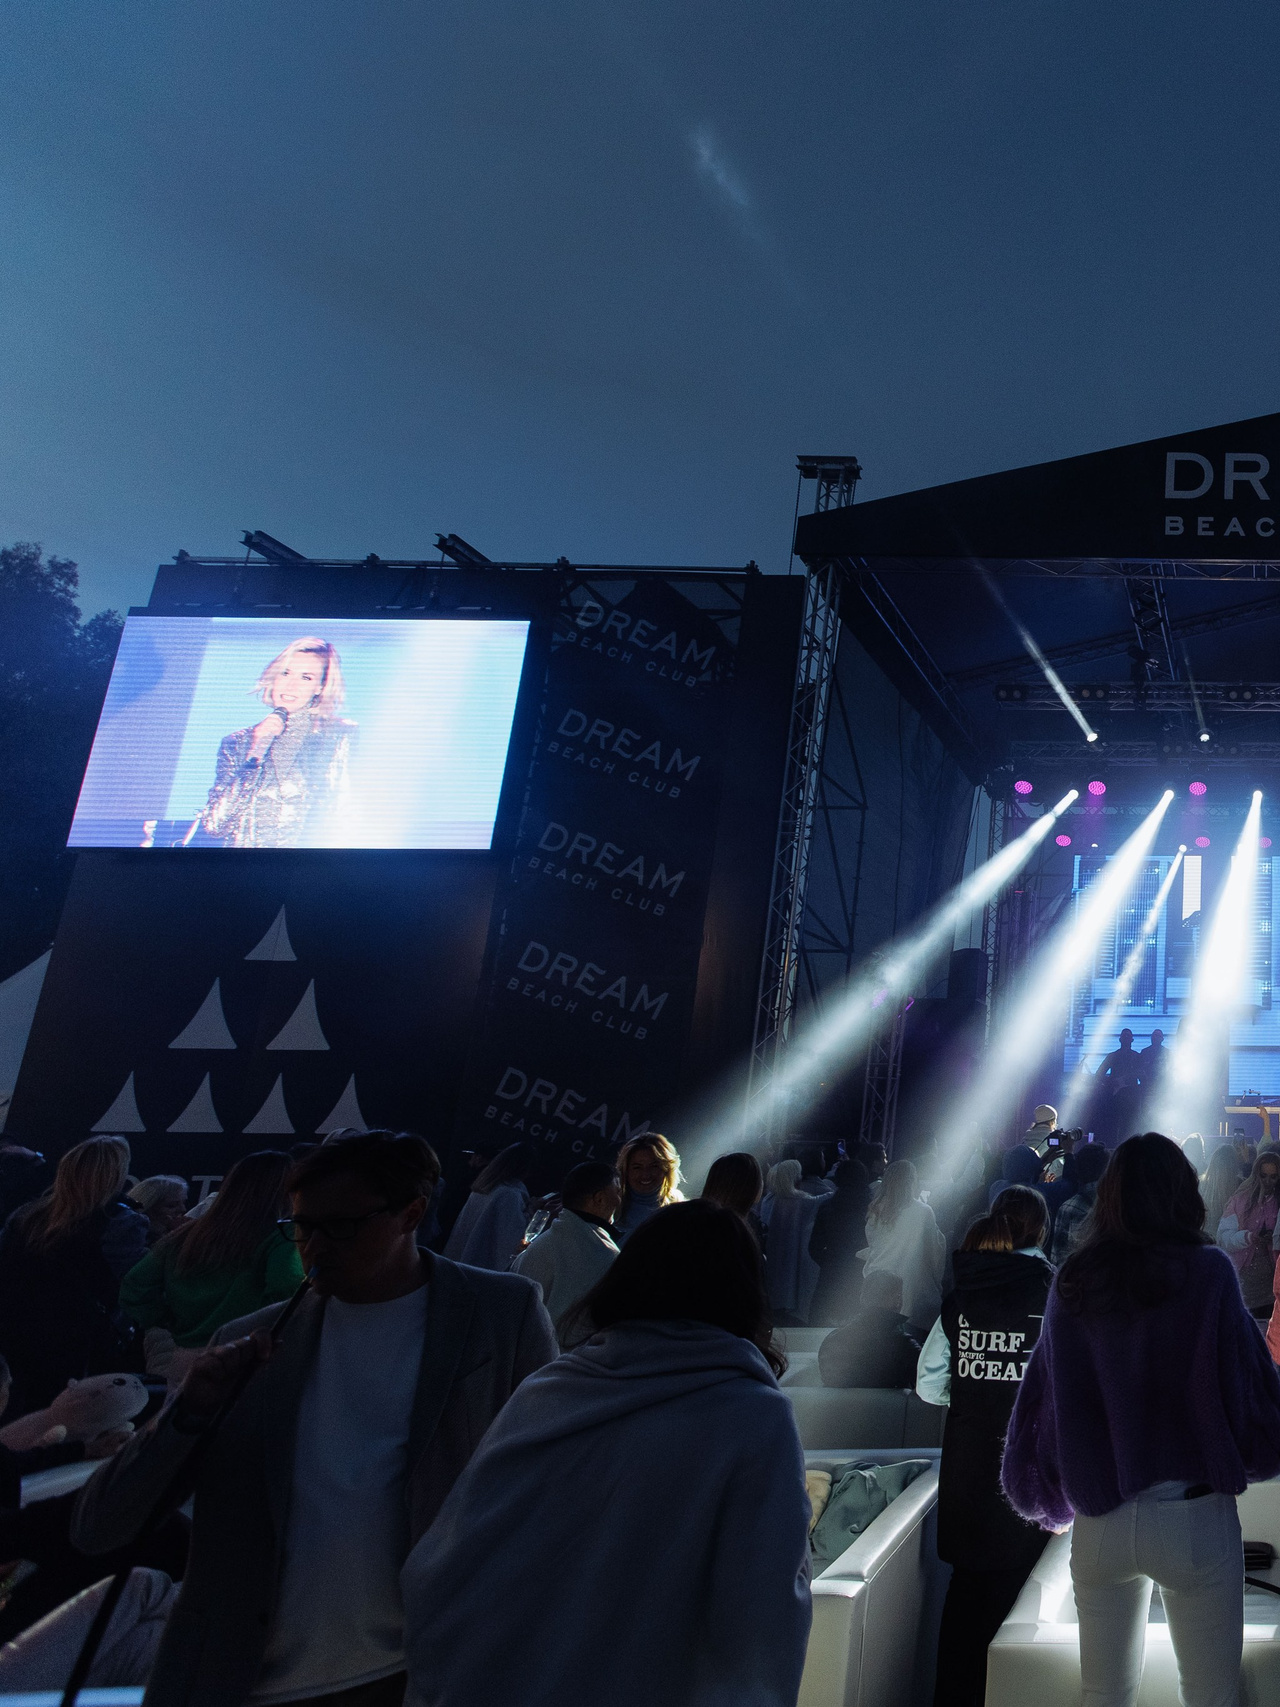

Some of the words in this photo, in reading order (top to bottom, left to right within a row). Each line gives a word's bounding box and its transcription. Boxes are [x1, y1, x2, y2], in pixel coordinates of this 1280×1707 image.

[566, 631, 634, 664] BEACH
[644, 660, 697, 688] CLUB
[574, 600, 717, 671] DREAM
[547, 741, 616, 775] BEACH
[627, 770, 682, 799] CLUB
[556, 708, 701, 782] DREAM
[527, 856, 598, 891] BEACH
[610, 887, 666, 917] CLUB
[537, 821, 687, 898] DREAM
[506, 976, 579, 1014] BEACH
[591, 1010, 648, 1040] CLUB
[516, 940, 670, 1021] DREAM
[483, 1104, 559, 1144] BEACH
[571, 1139, 596, 1160] CL
[494, 1066, 651, 1143] DREAM
[957, 1329, 1026, 1353] SURF
